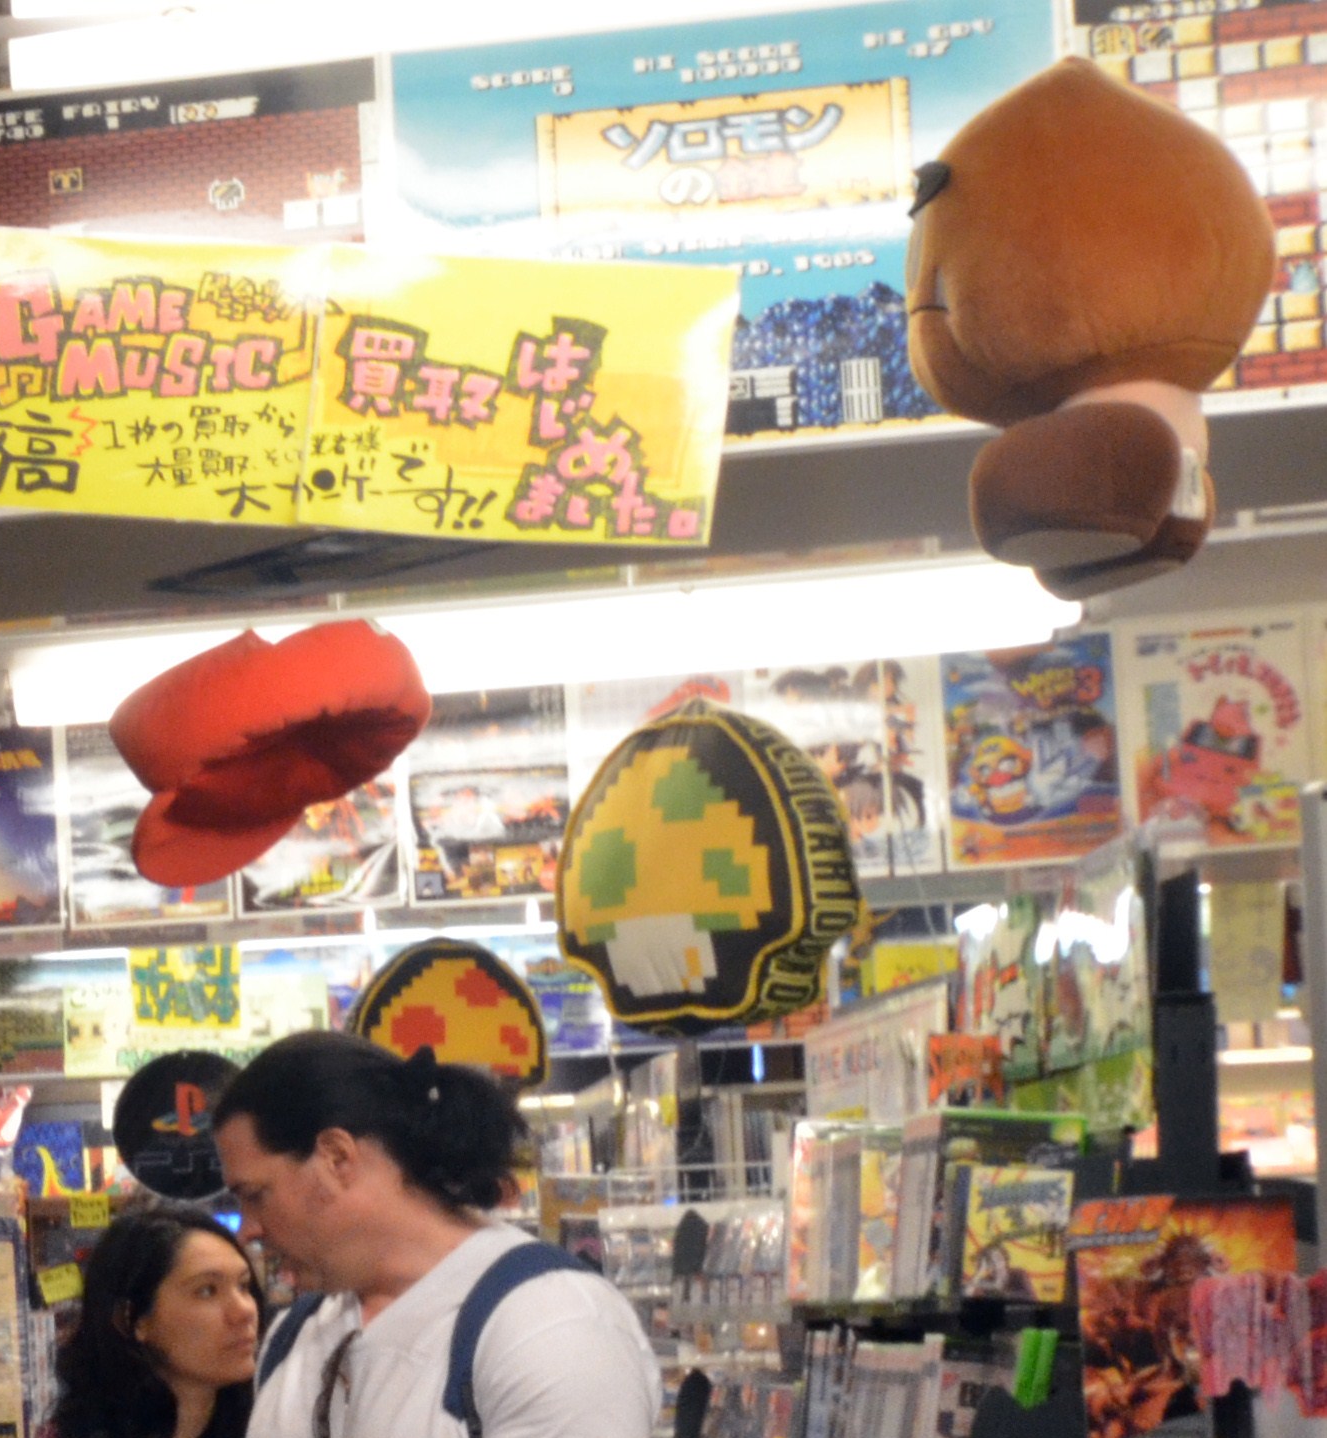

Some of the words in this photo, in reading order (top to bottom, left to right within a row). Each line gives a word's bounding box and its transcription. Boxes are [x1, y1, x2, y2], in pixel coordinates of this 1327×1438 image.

[695, 41, 800, 67] SCORE
[470, 66, 573, 91] SCORE
[62, 95, 160, 121] FAIRY
[601, 102, 846, 171] ソロモン
[50, 331, 281, 404] MUSIC
[338, 315, 503, 428] 買取
